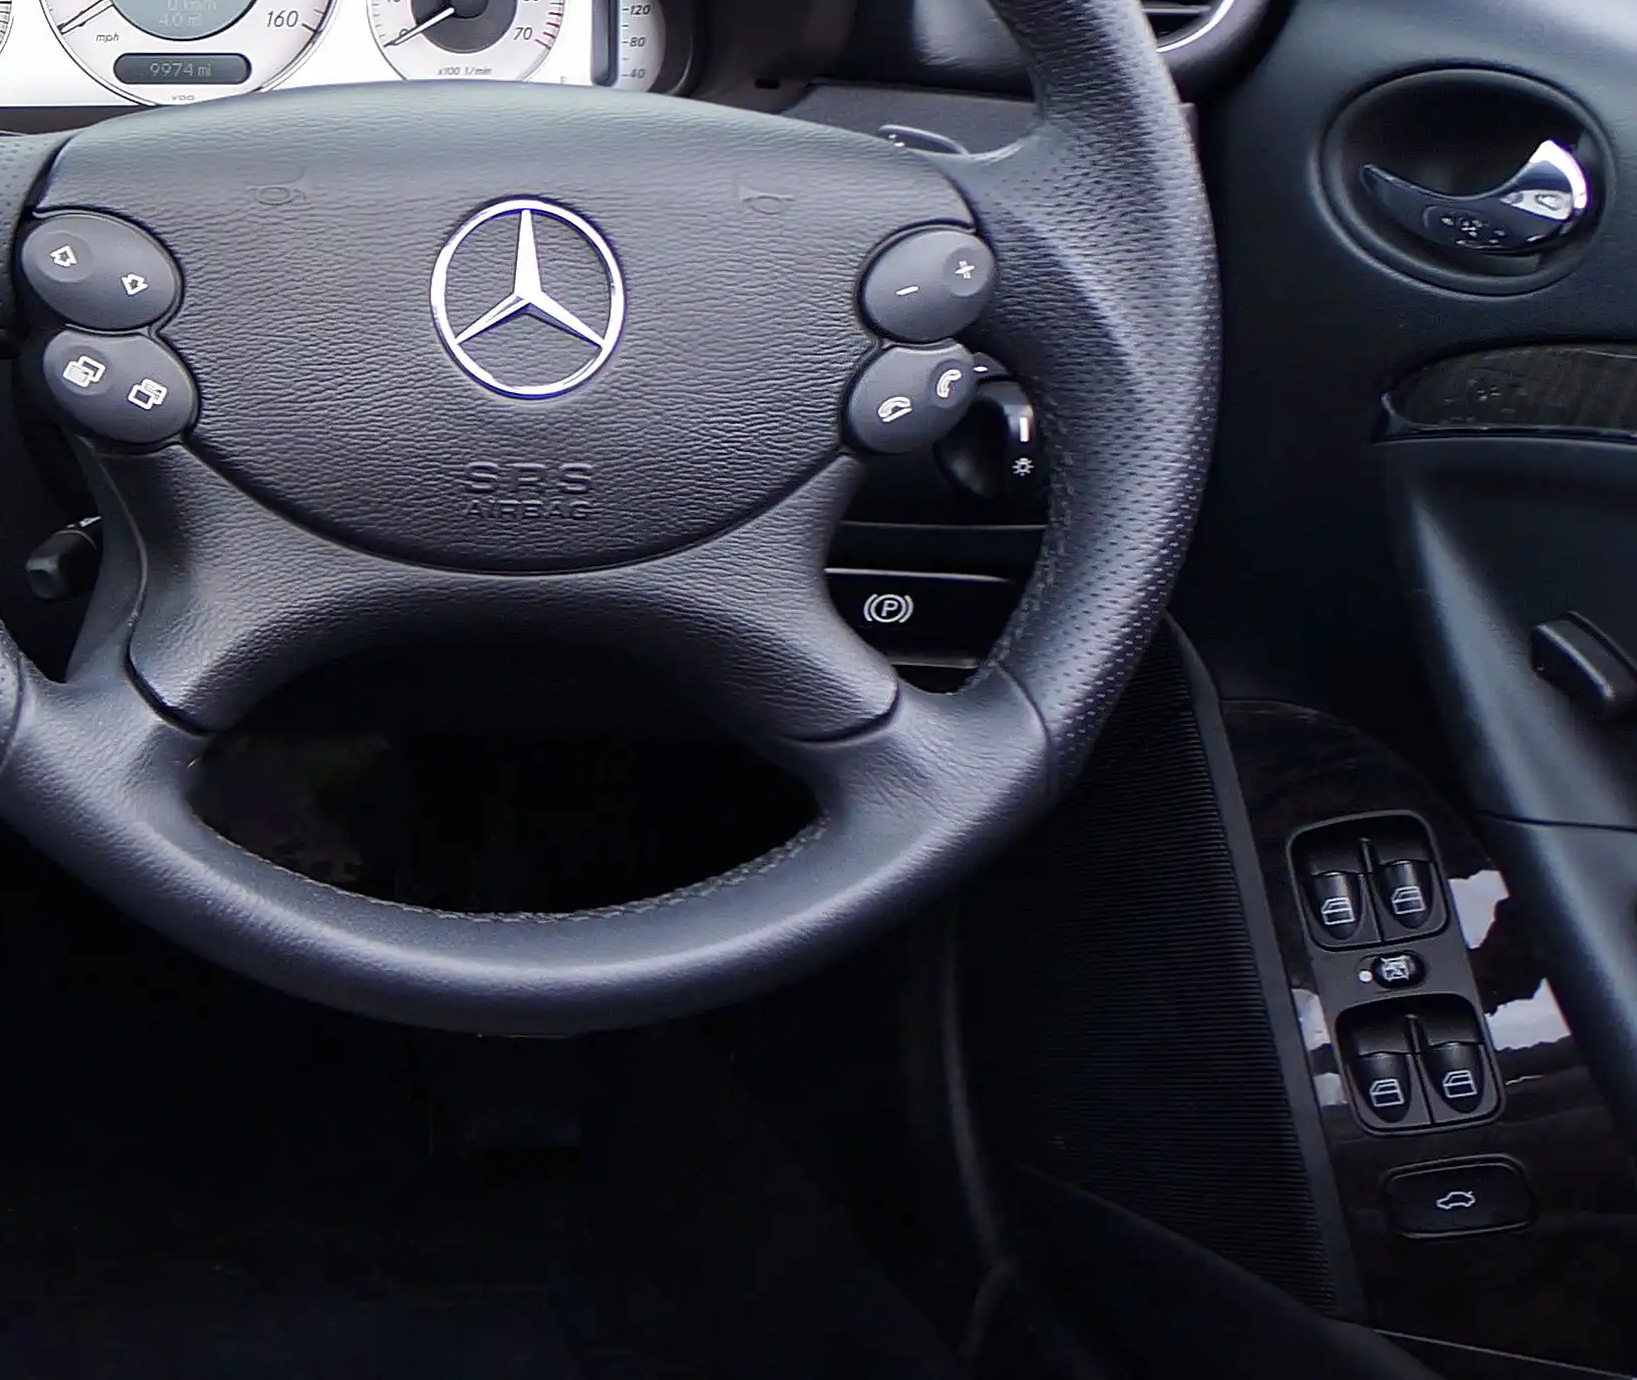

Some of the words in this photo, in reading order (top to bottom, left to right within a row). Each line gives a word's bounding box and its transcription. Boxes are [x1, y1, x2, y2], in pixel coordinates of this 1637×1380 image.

[630, 4, 651, 15] 120
[266, 10, 300, 28] 160
[95, 31, 120, 42] mph
[513, 27, 533, 41] 70
[630, 36, 647, 48] 80
[630, 68, 646, 80] 40
[466, 461, 594, 494] SRS
[463, 498, 592, 520] AIRBAG
